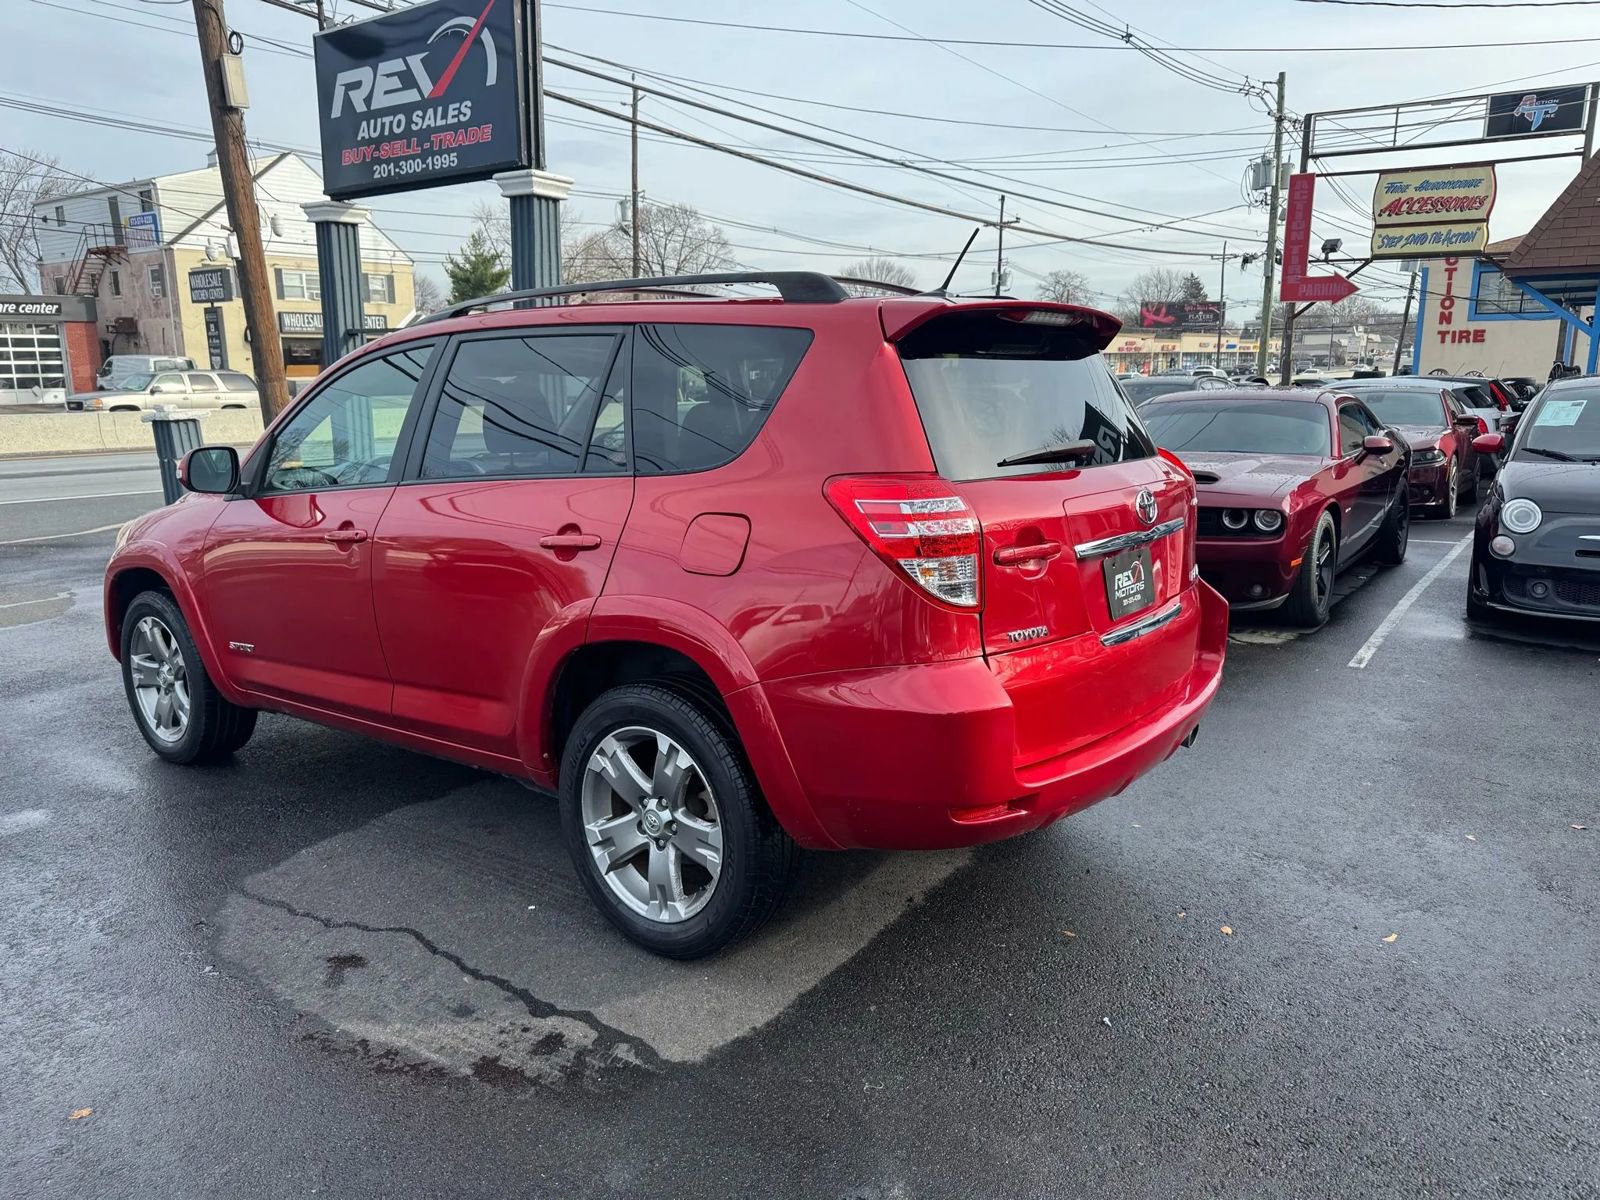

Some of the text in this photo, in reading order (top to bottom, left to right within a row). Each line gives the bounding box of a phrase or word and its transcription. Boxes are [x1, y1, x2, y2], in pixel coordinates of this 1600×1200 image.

[330, 36, 455, 120] REV
[356, 100, 472, 141] AUTO SALES
[372, 152, 458, 179] 201-300-1995
[1378, 195, 1489, 217] ACCESSORIES
[1286, 179, 1310, 284] ACTION TIRE
[190, 272, 223, 289] WHOLESALE
[1297, 283, 1349, 298] PARKING
[18, 302, 58, 314] center
[1437, 256, 1486, 344] CTION TIRE
[282, 313, 385, 329] WHOLESAL ENTER
[1114, 581, 1145, 600] MOTORS
[1008, 625, 1048, 643] TOYOTA
